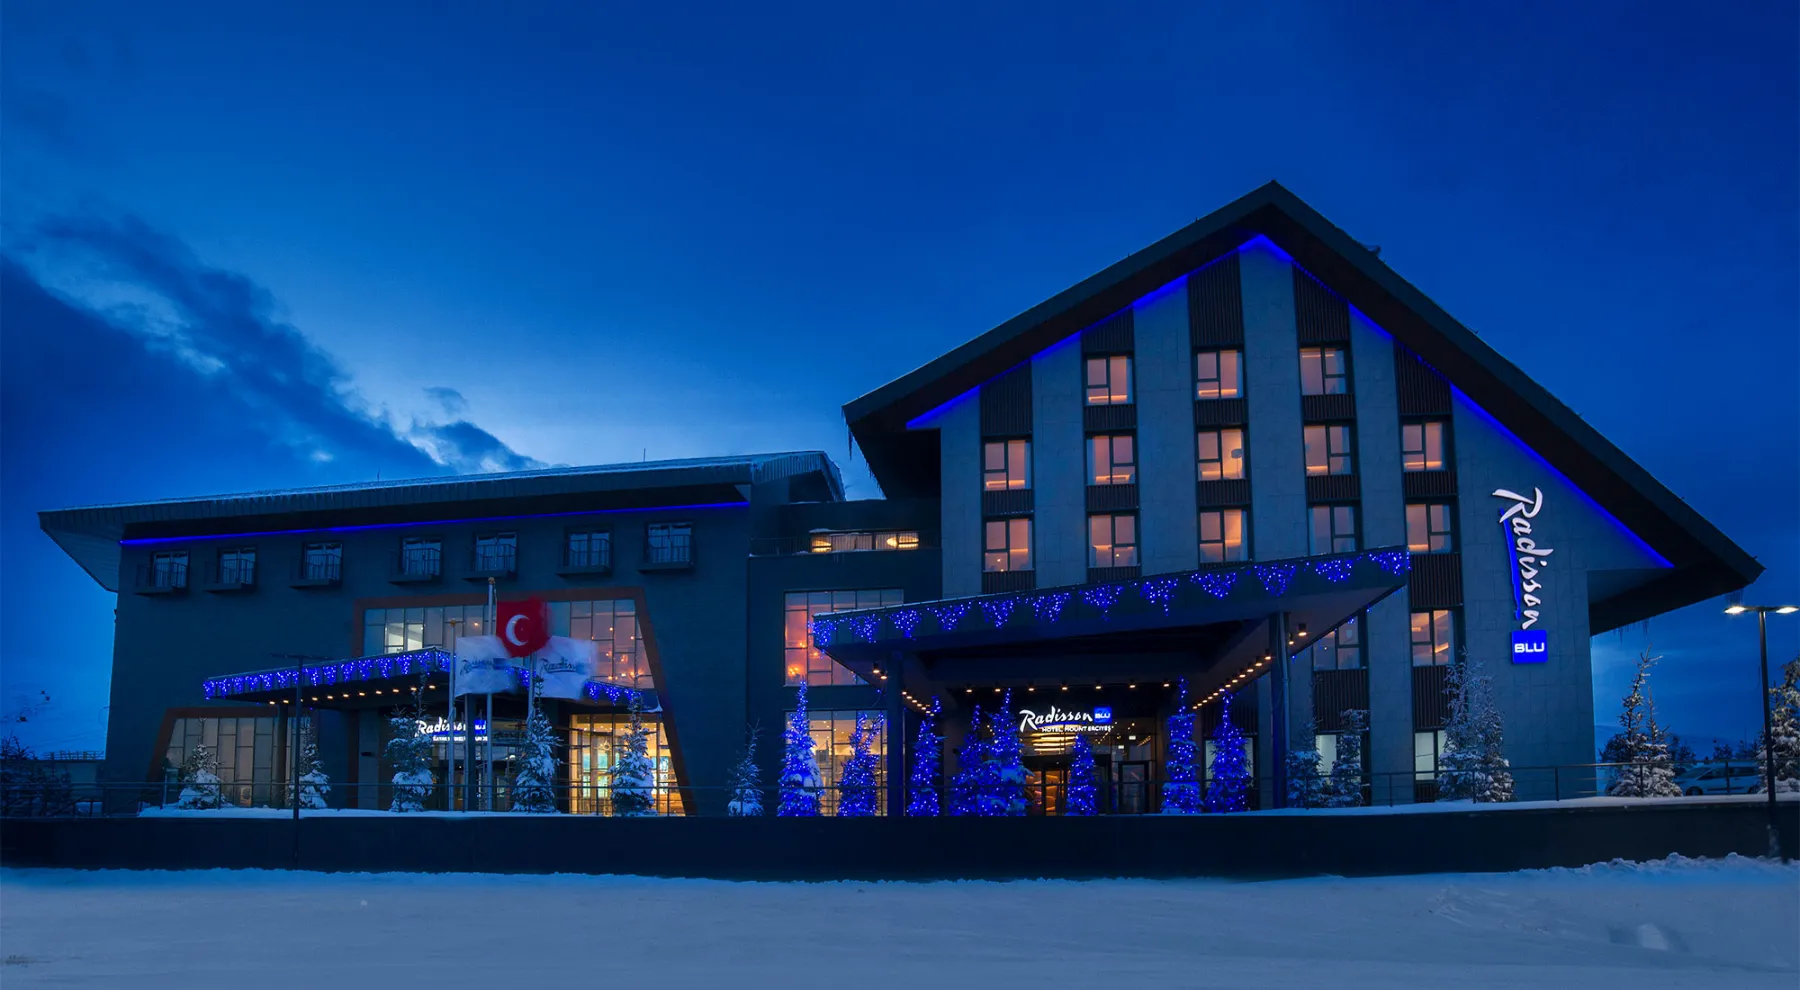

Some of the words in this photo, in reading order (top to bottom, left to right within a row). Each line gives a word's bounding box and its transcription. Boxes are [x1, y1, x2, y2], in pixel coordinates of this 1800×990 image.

[1492, 487, 1554, 630] Radisson
[1514, 642, 1545, 654] BLU
[1019, 705, 1093, 733] Radisson
